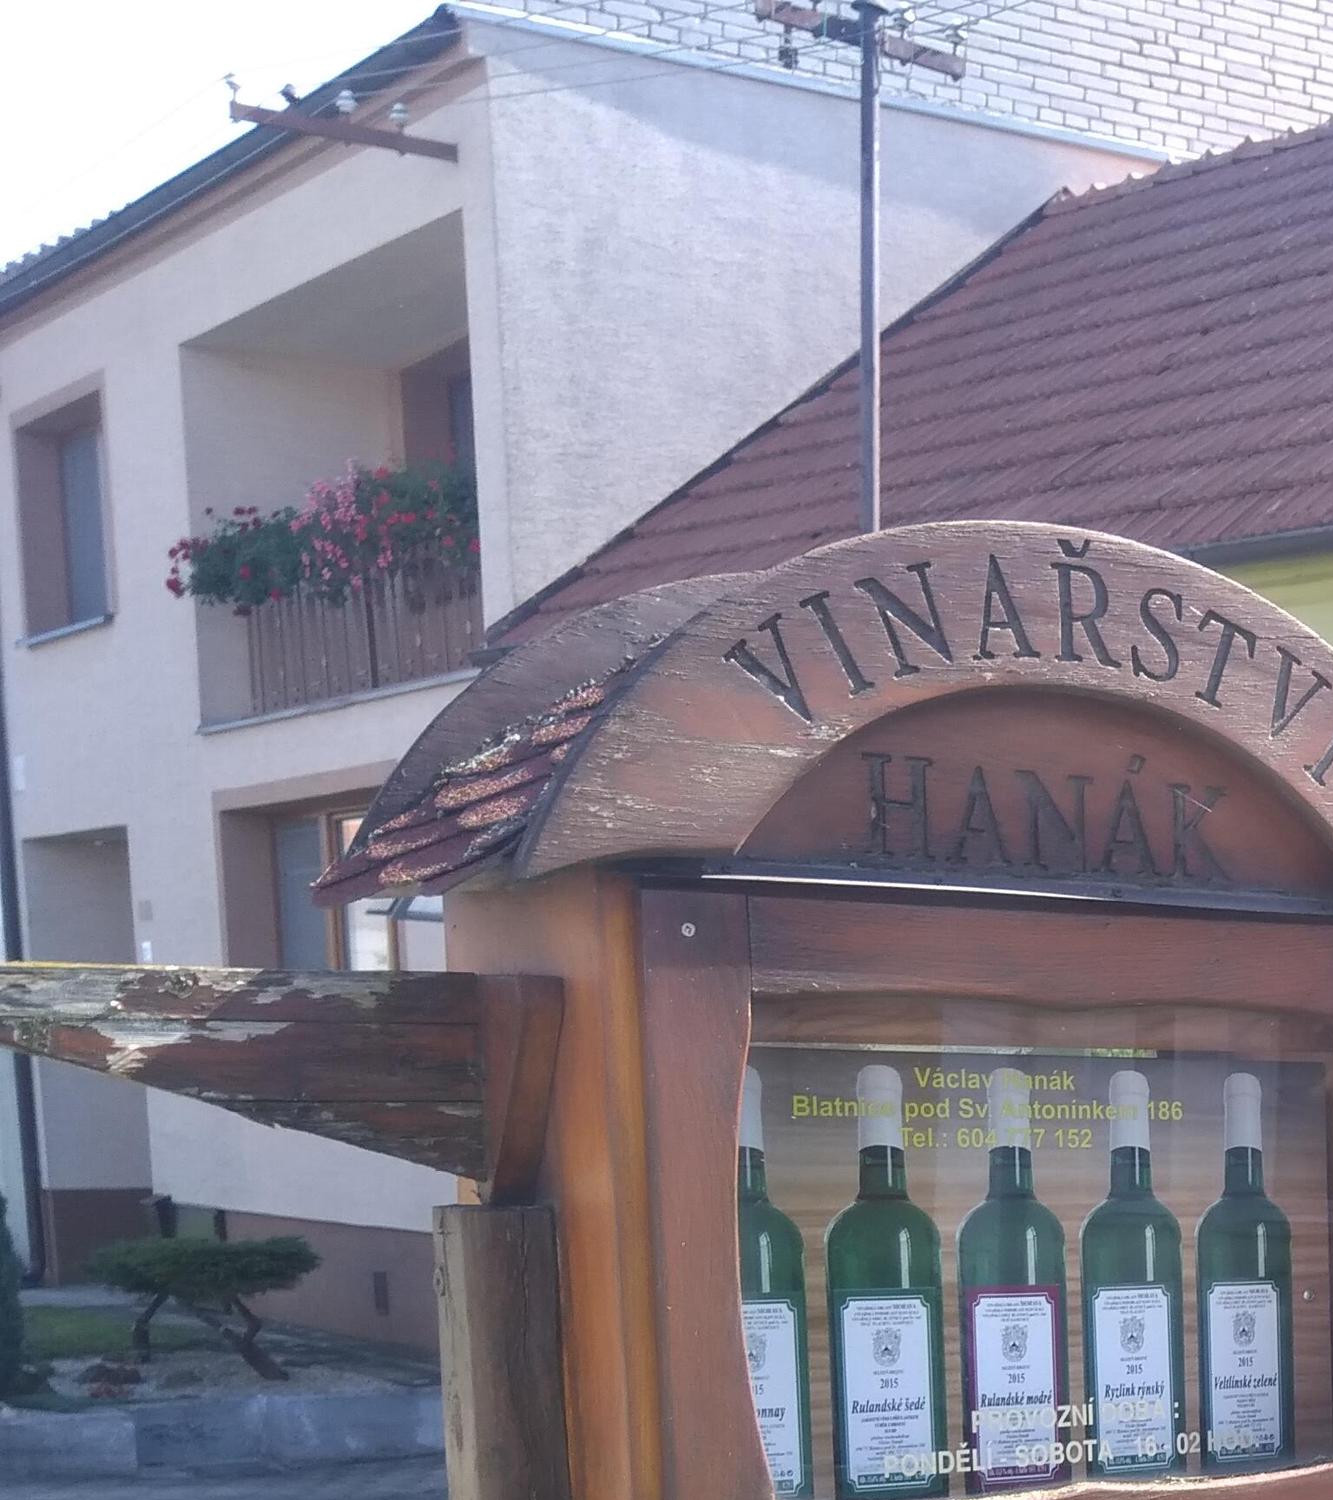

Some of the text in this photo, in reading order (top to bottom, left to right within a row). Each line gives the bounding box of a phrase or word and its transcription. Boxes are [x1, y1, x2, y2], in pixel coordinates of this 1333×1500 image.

[861, 751, 1236, 883] HANÁK
[914, 1066, 993, 1089] Václav
[904, 1097, 949, 1122] pod
[1147, 1101, 1184, 1121] 186
[900, 1126, 948, 1149] Tel.:
[956, 1127, 998, 1148] 604
[1054, 1128, 1094, 1149] 152
[1125, 1363, 1144, 1375] 2015
[1237, 1356, 1254, 1368] 2015
[879, 1377, 900, 1390] 2015
[1007, 1372, 1026, 1385] 2015
[980, 1389, 1053, 1408] Rulandské modré
[1104, 1380, 1166, 1401] Ryzlink rýnský
[851, 1397, 903, 1414] Rulandské
[1014, 1439, 1114, 1468] SOBOTA
